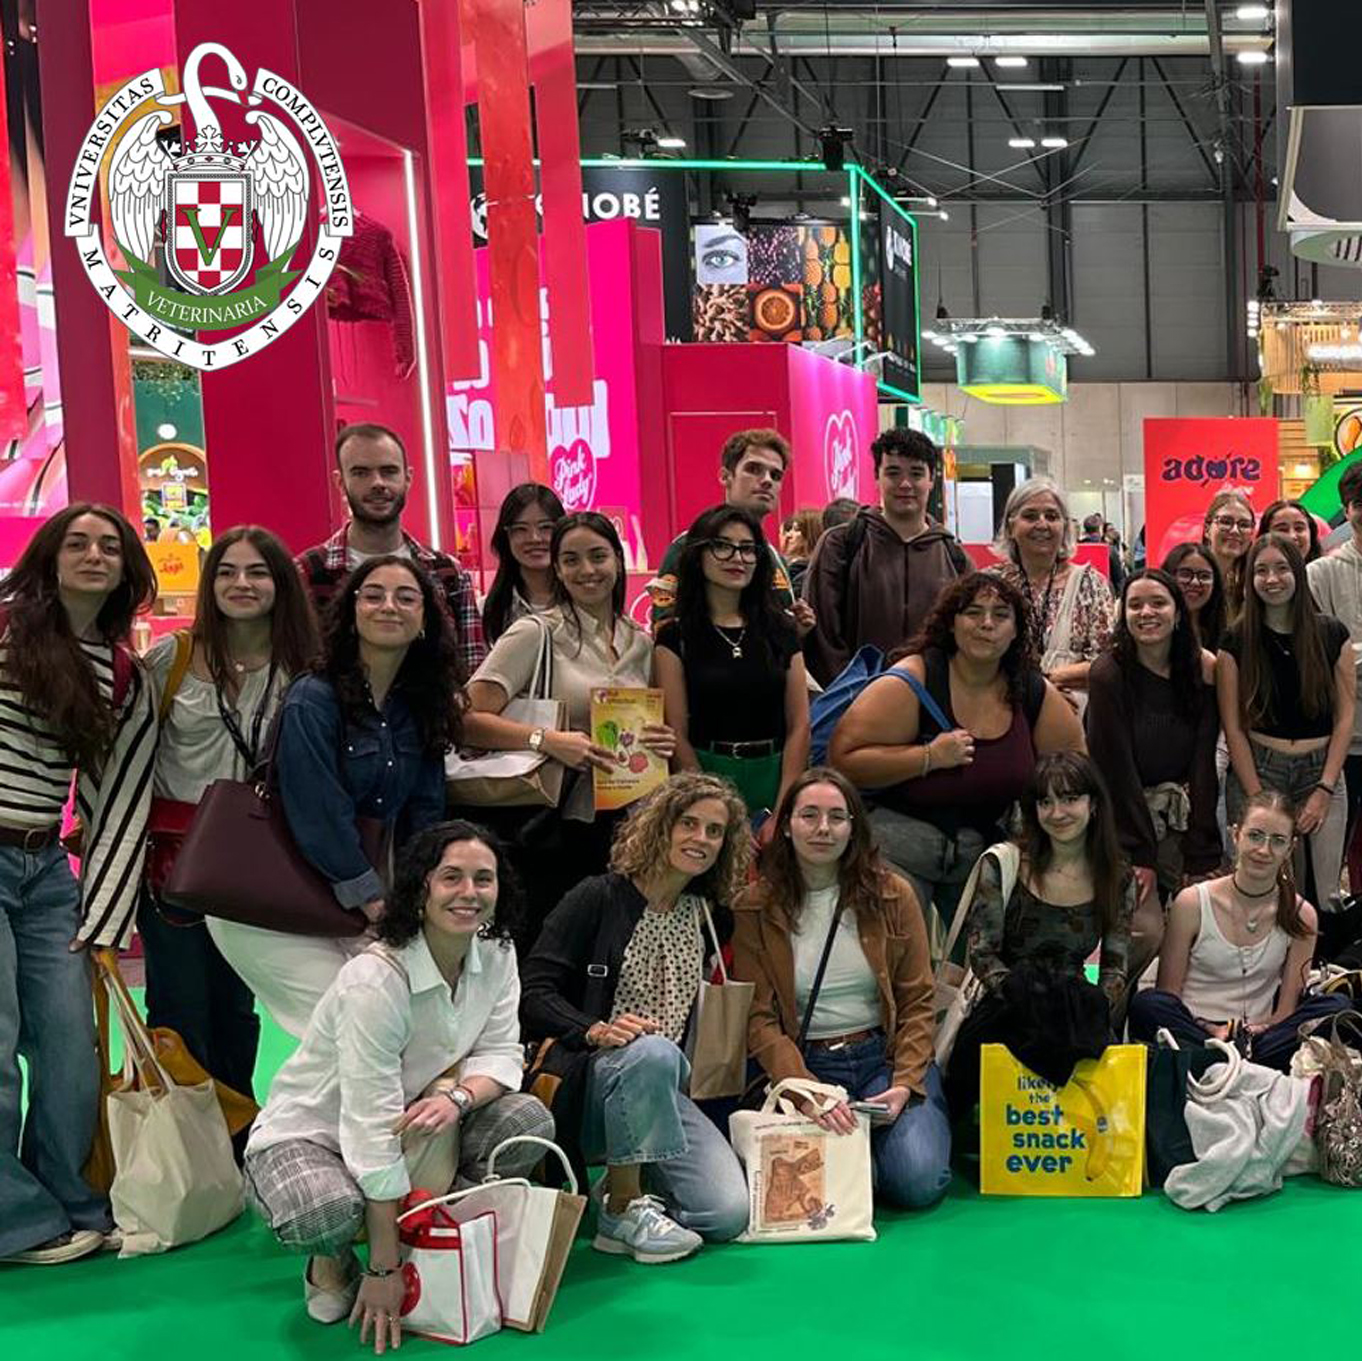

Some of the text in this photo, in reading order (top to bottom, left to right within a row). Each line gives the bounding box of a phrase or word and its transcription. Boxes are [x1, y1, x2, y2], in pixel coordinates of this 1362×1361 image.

[1029, 1093, 1051, 1103] the
[1006, 1103, 1063, 1125] best
[1013, 1128, 1087, 1148] snack
[1006, 1154, 1072, 1173] ever
